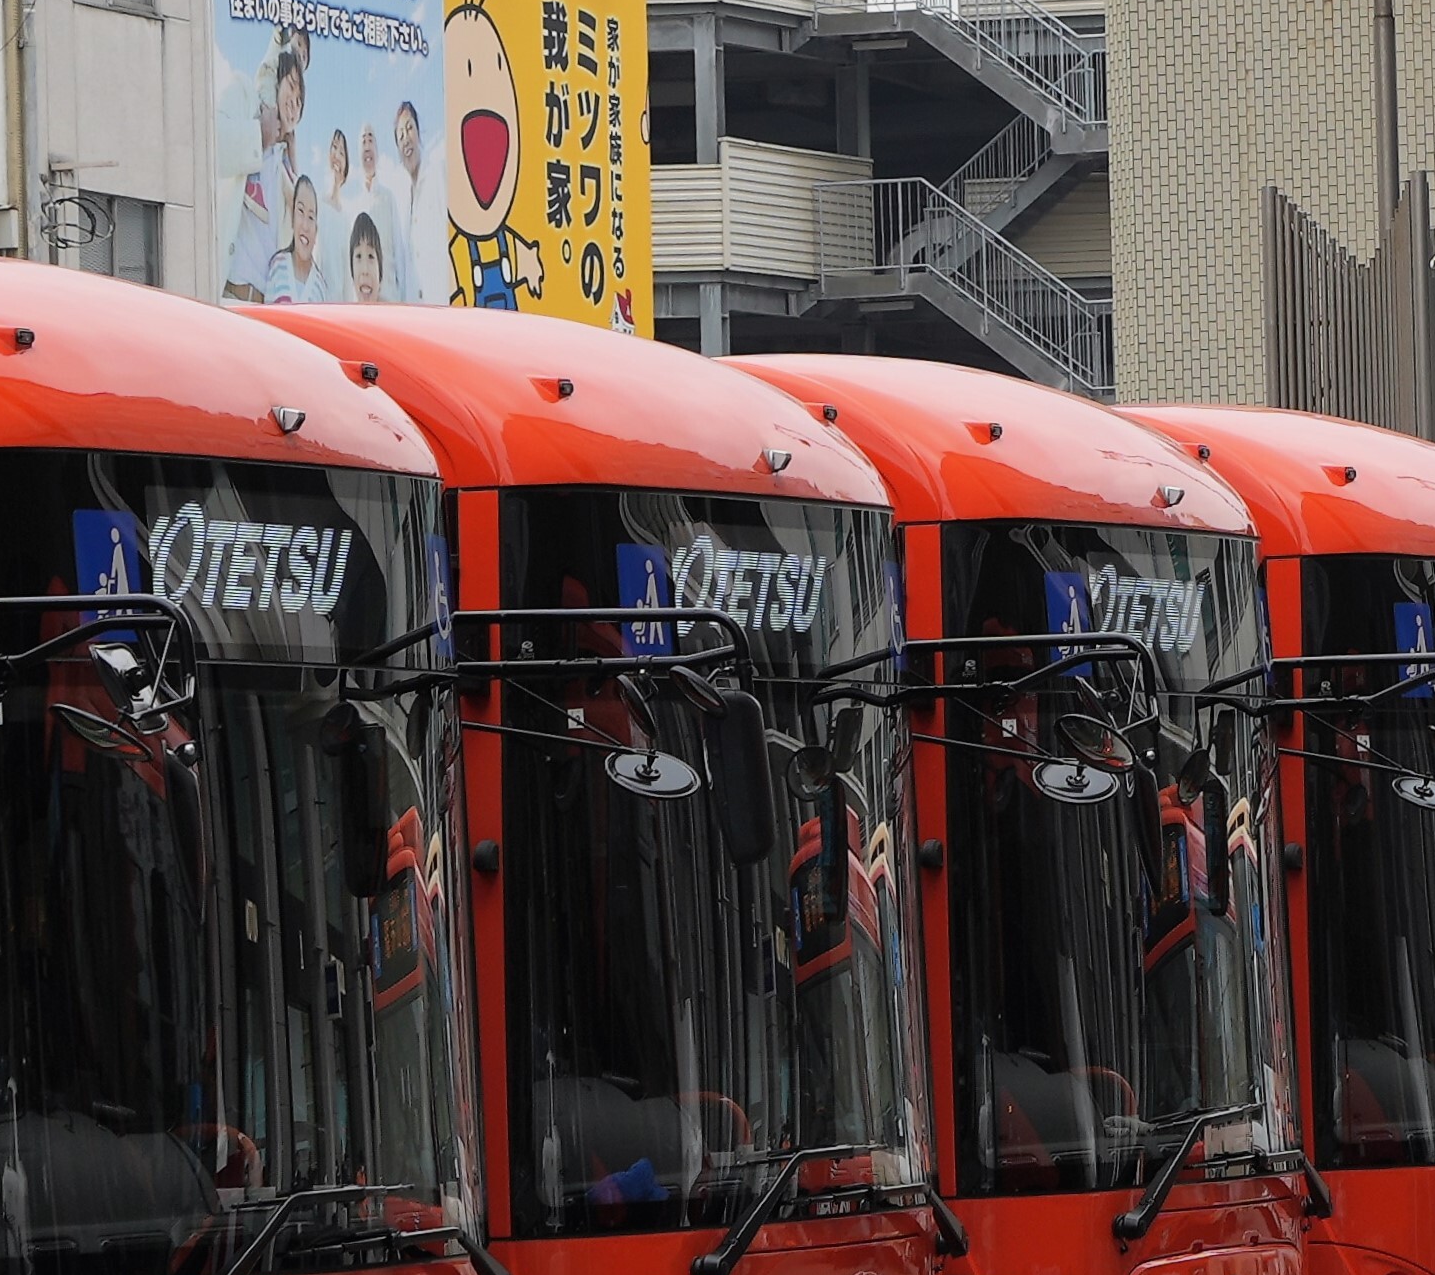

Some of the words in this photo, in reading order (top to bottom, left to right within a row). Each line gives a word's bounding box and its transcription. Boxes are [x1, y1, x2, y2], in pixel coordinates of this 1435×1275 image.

[542, 0, 572, 265] 我が家。
[577, 8, 604, 306] ミツワの
[606, 17, 624, 278] 家が家族になる
